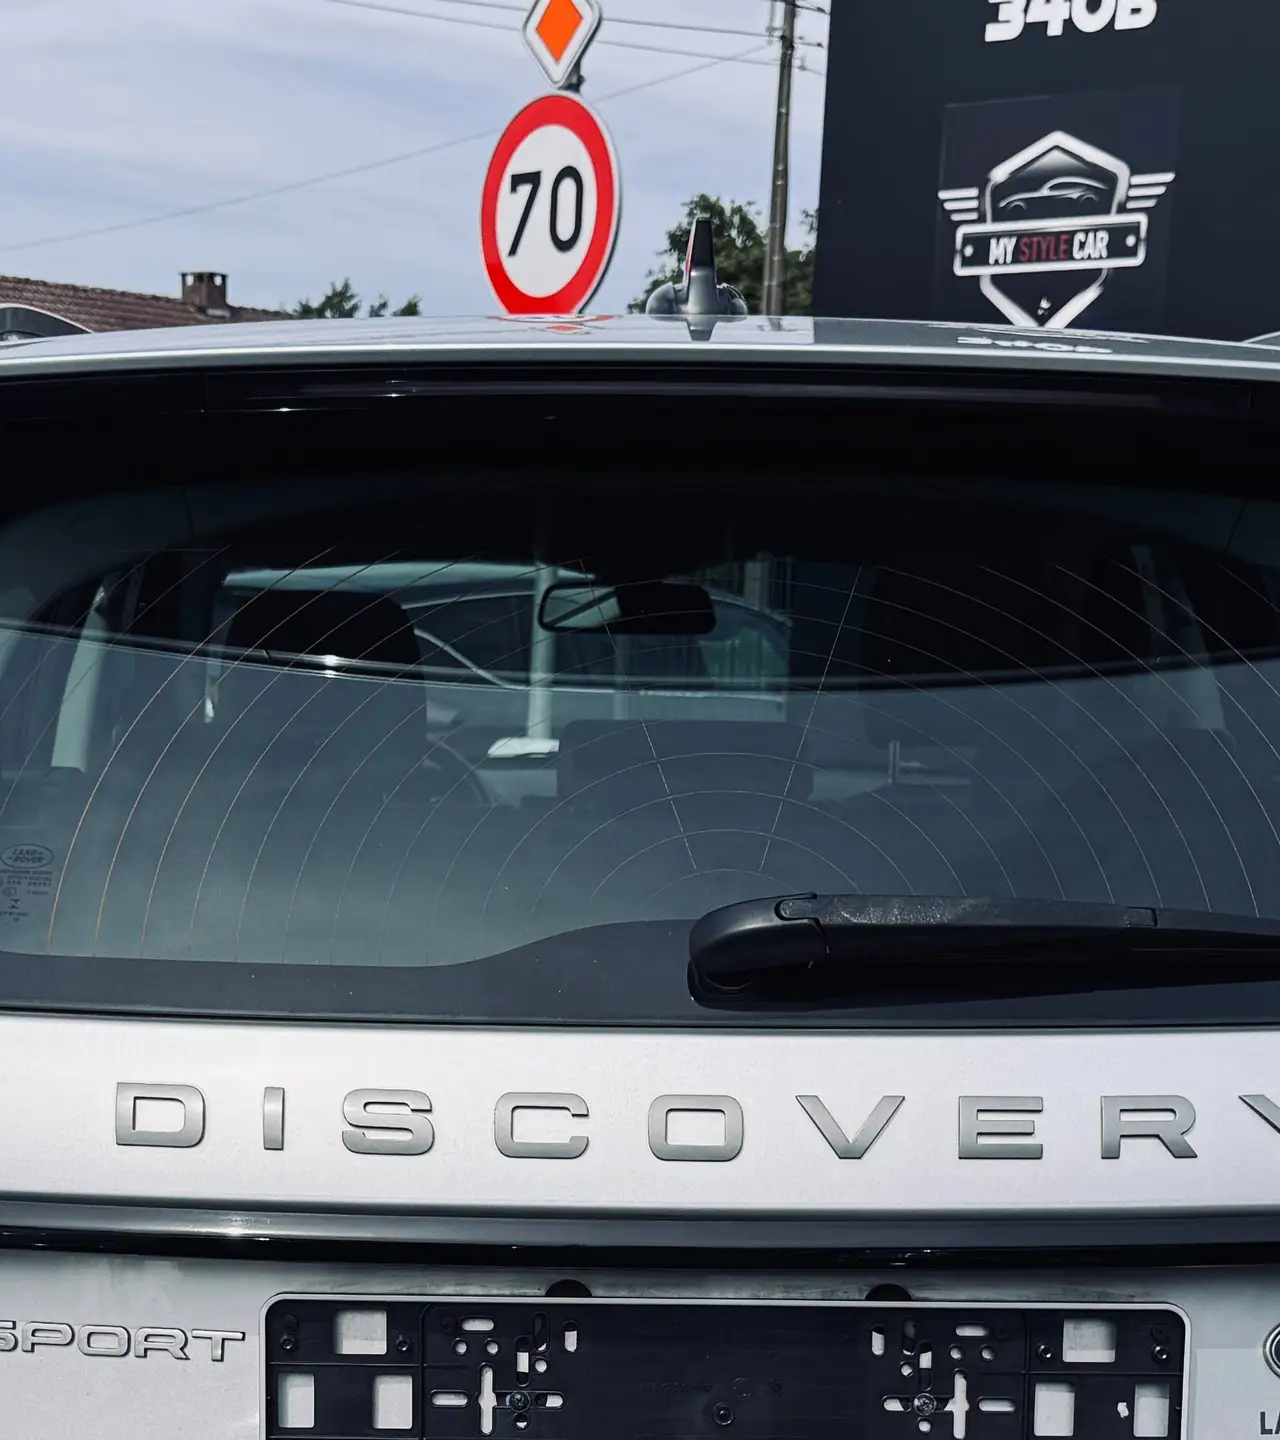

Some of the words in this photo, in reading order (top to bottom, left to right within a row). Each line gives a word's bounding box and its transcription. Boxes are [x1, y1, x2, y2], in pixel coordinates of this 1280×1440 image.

[508, 165, 584, 257] 70
[988, 236, 1017, 265] MY
[1020, 234, 1070, 262] STYLE
[1073, 230, 1109, 259] CAR
